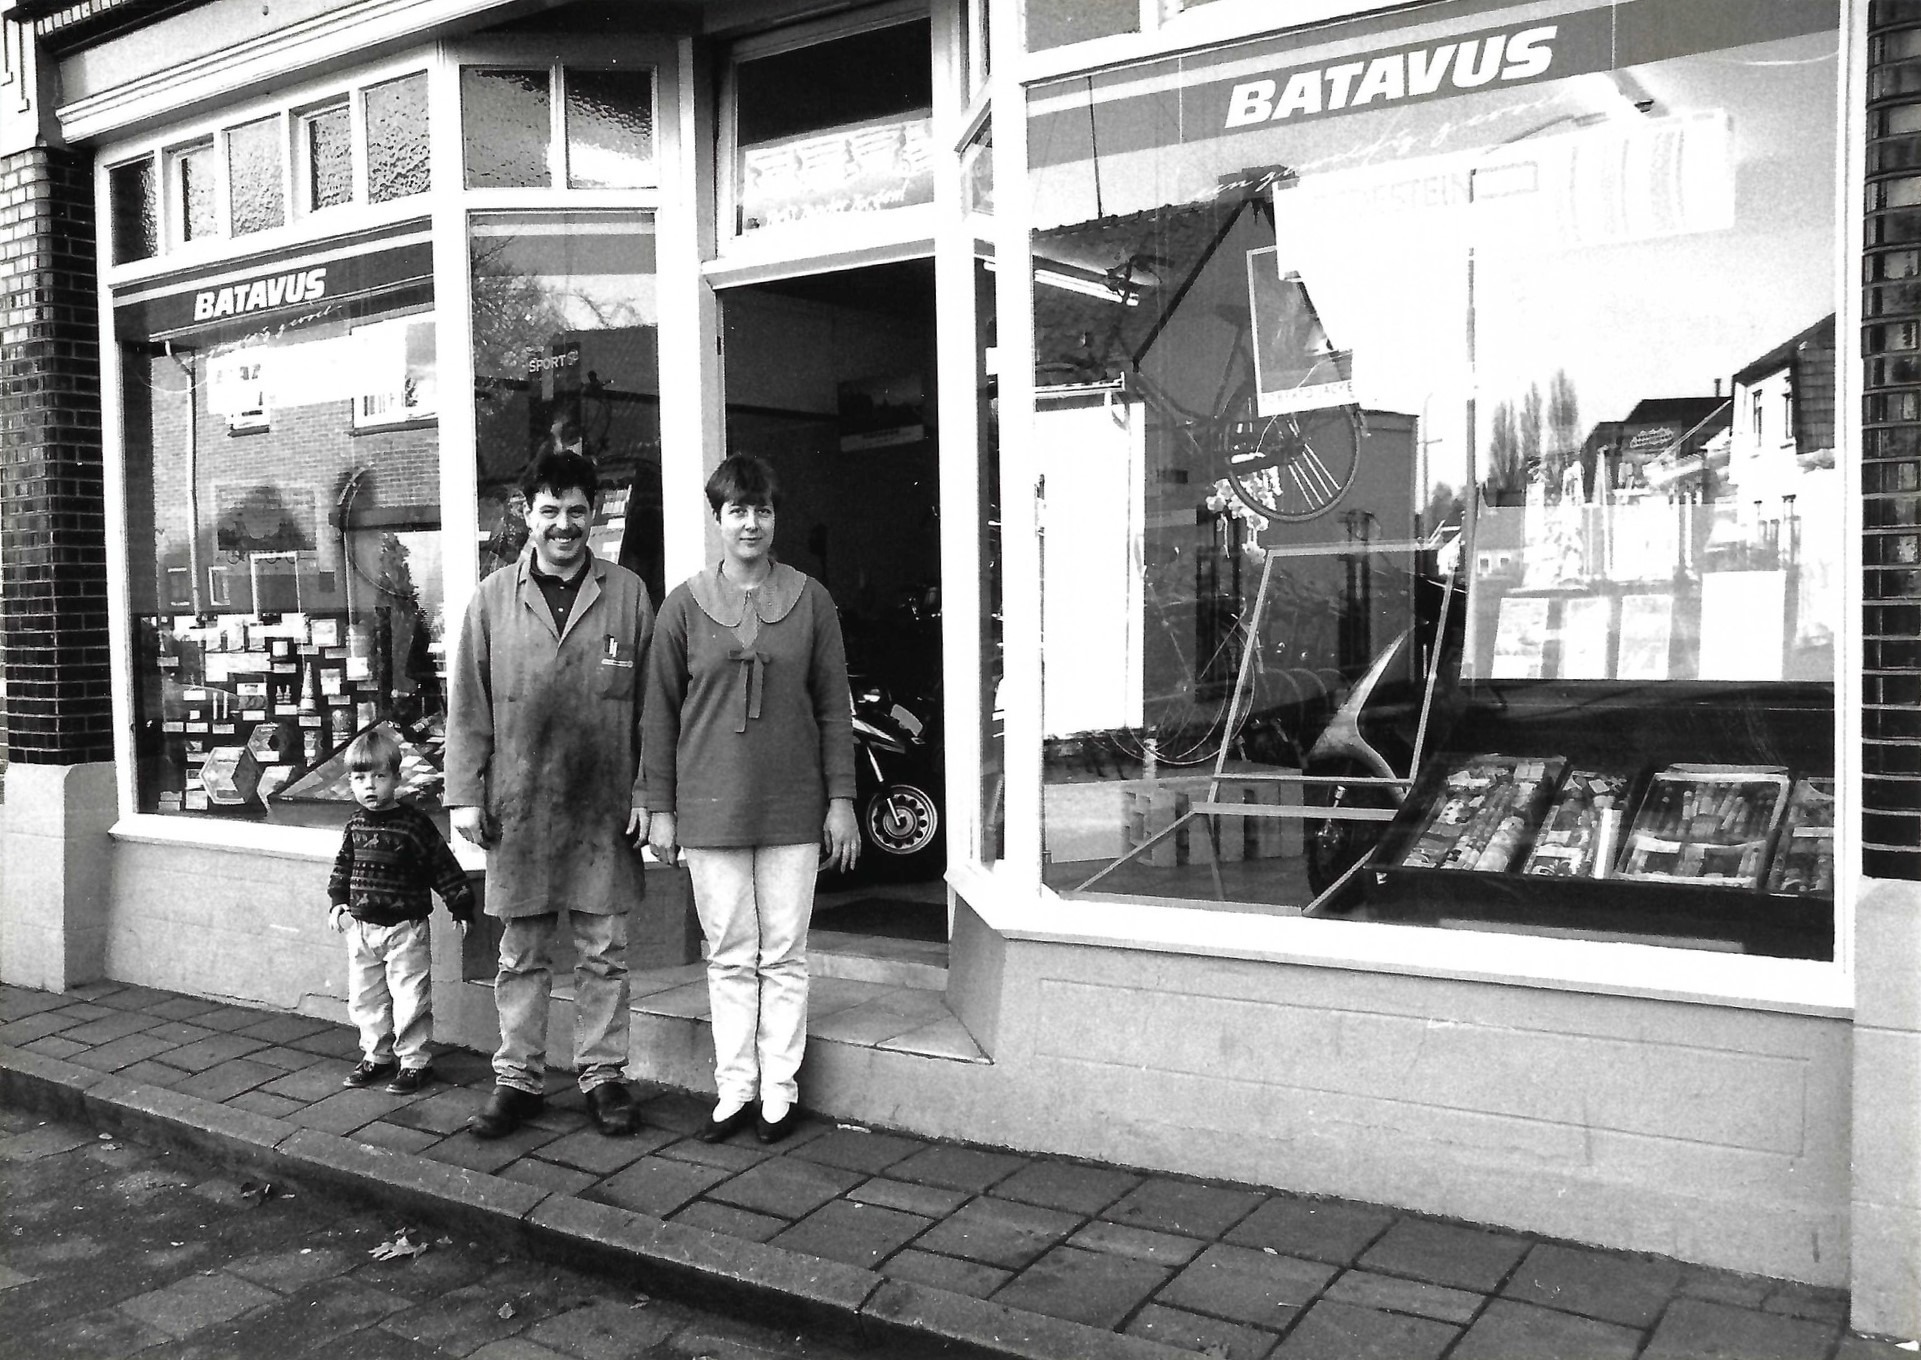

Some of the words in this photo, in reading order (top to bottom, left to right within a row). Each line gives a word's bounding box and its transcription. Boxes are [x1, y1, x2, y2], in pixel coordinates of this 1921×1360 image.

[1225, 26, 1557, 128] BATAVUS
[194, 268, 327, 321] BATAVUS
[529, 354, 567, 373] SPORT
